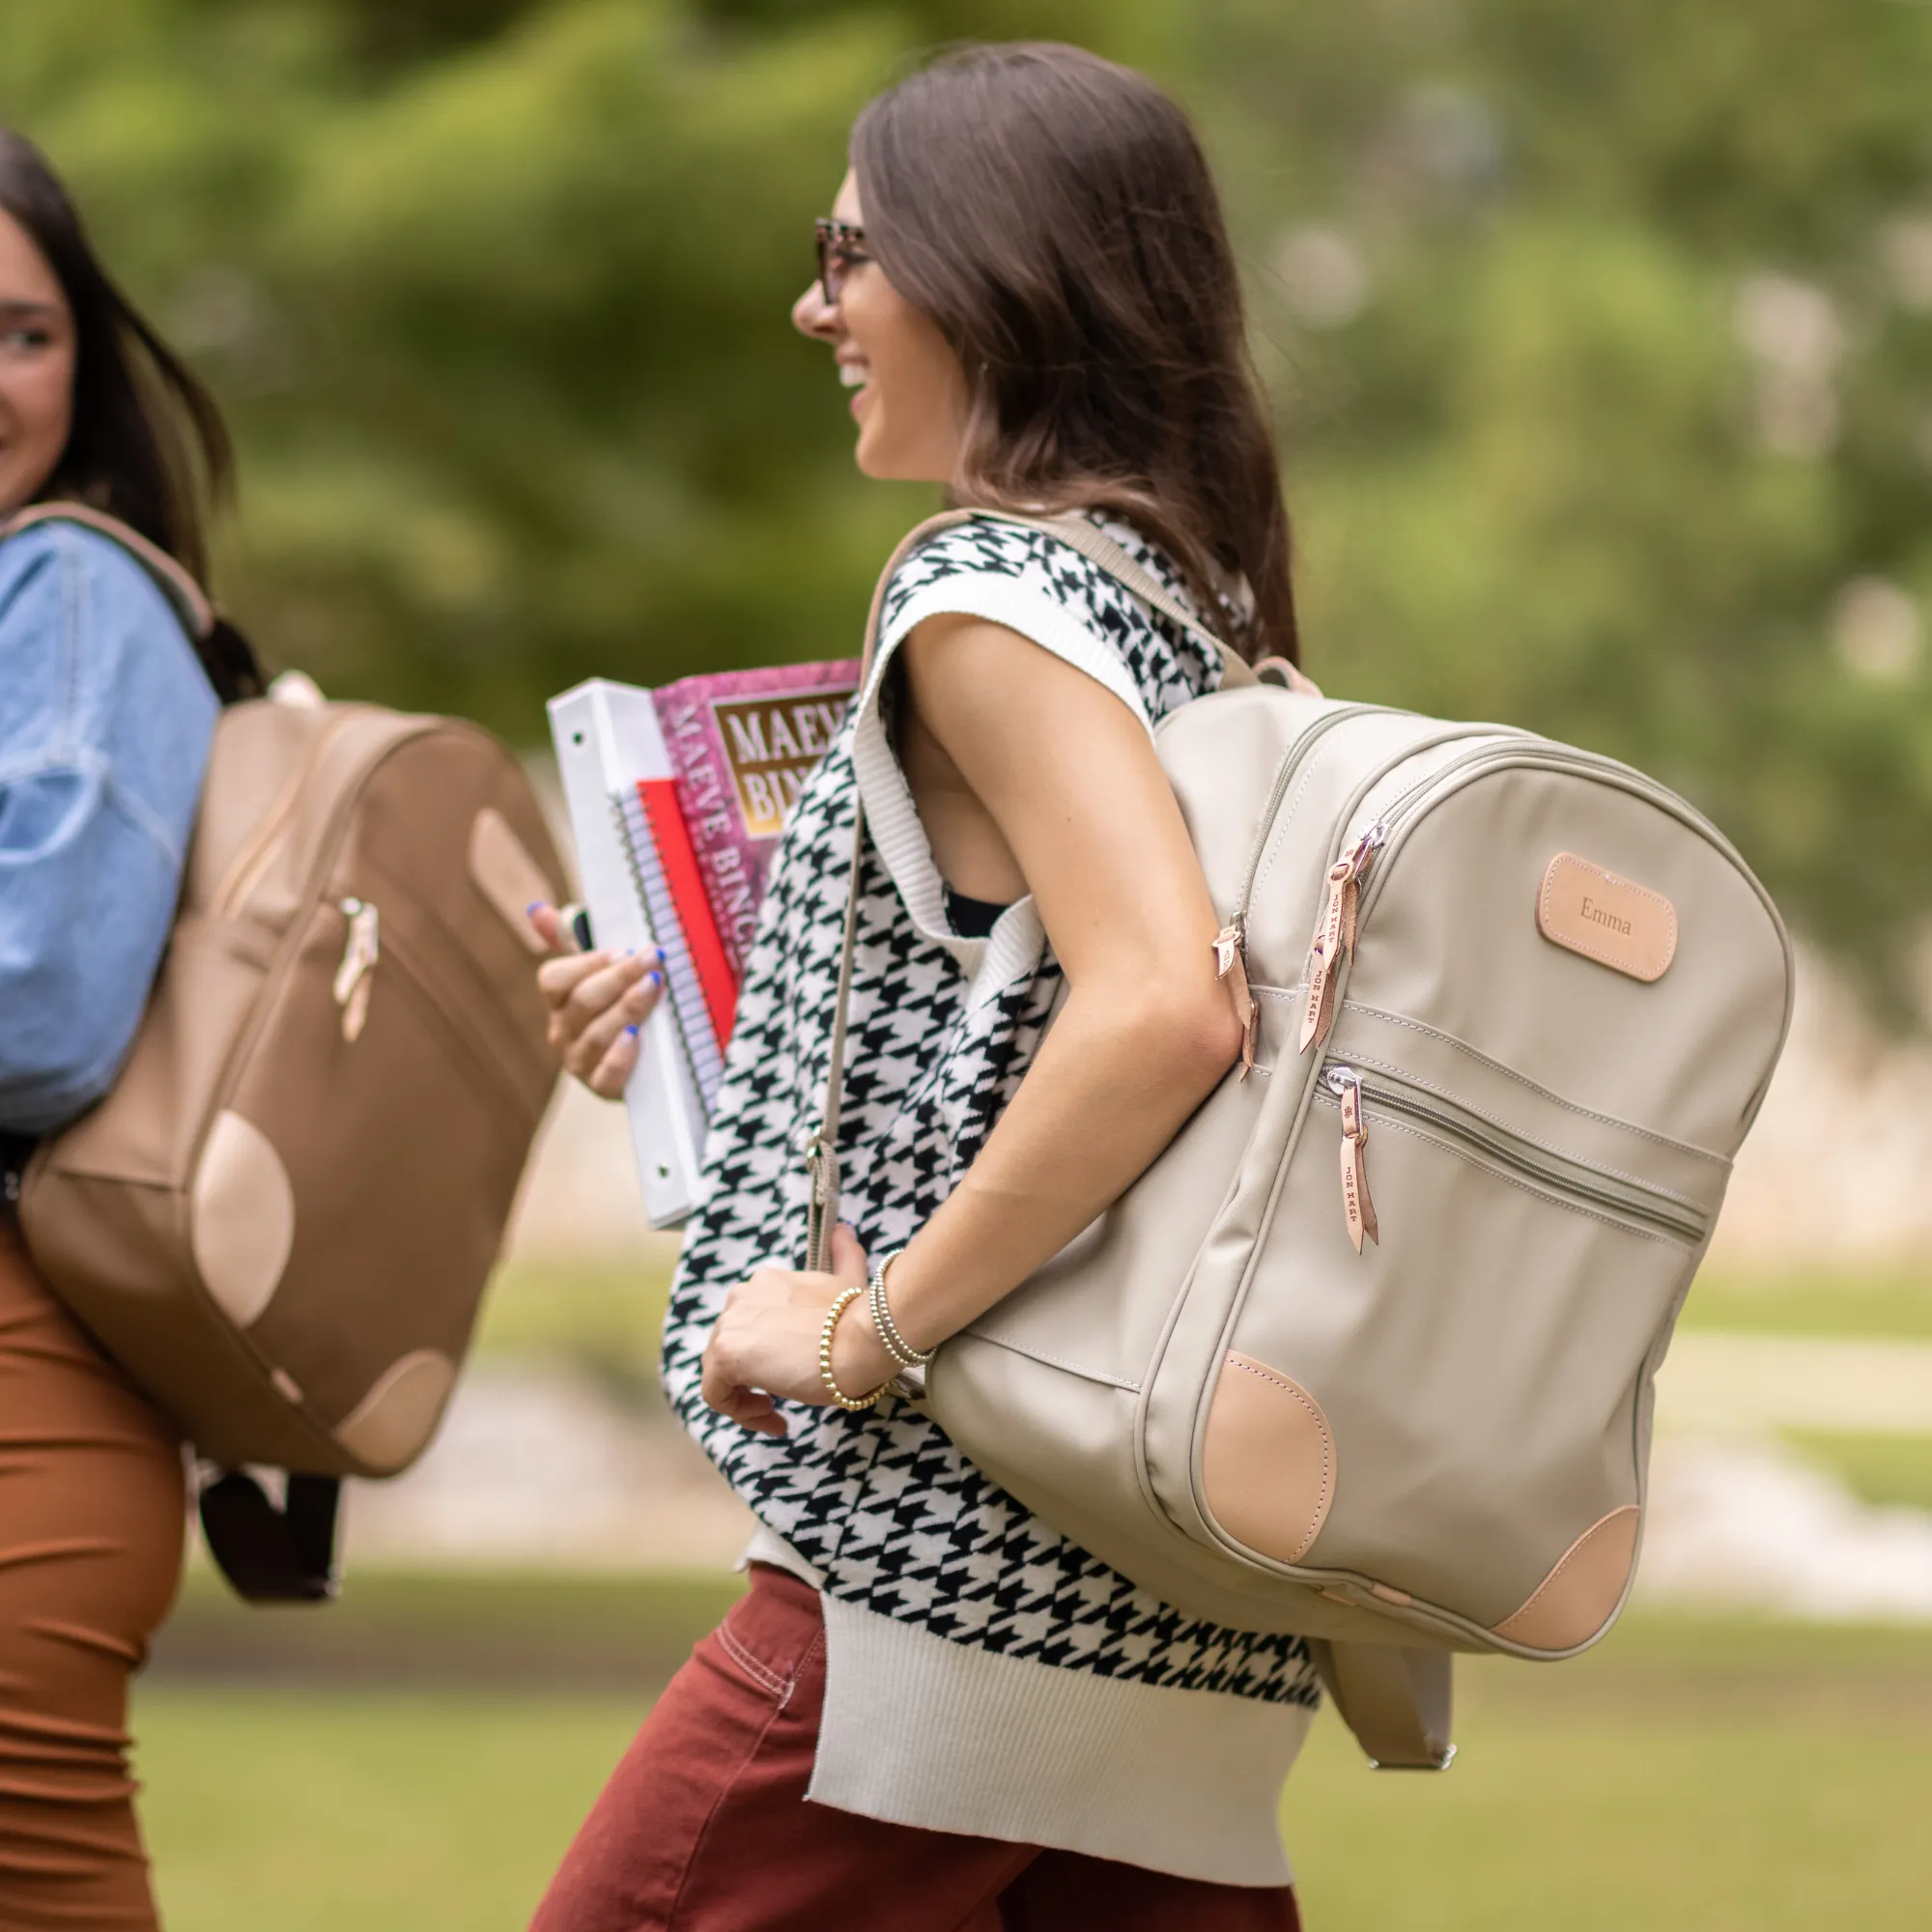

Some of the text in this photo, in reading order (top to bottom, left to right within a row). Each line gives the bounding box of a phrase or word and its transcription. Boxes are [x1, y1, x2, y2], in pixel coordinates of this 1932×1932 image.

[668, 703, 733, 840] MAEVE
[1580, 895, 1632, 936] Emma
[1307, 970, 1323, 1024] JON HART
[1345, 1166, 1357, 1222] JON HART
